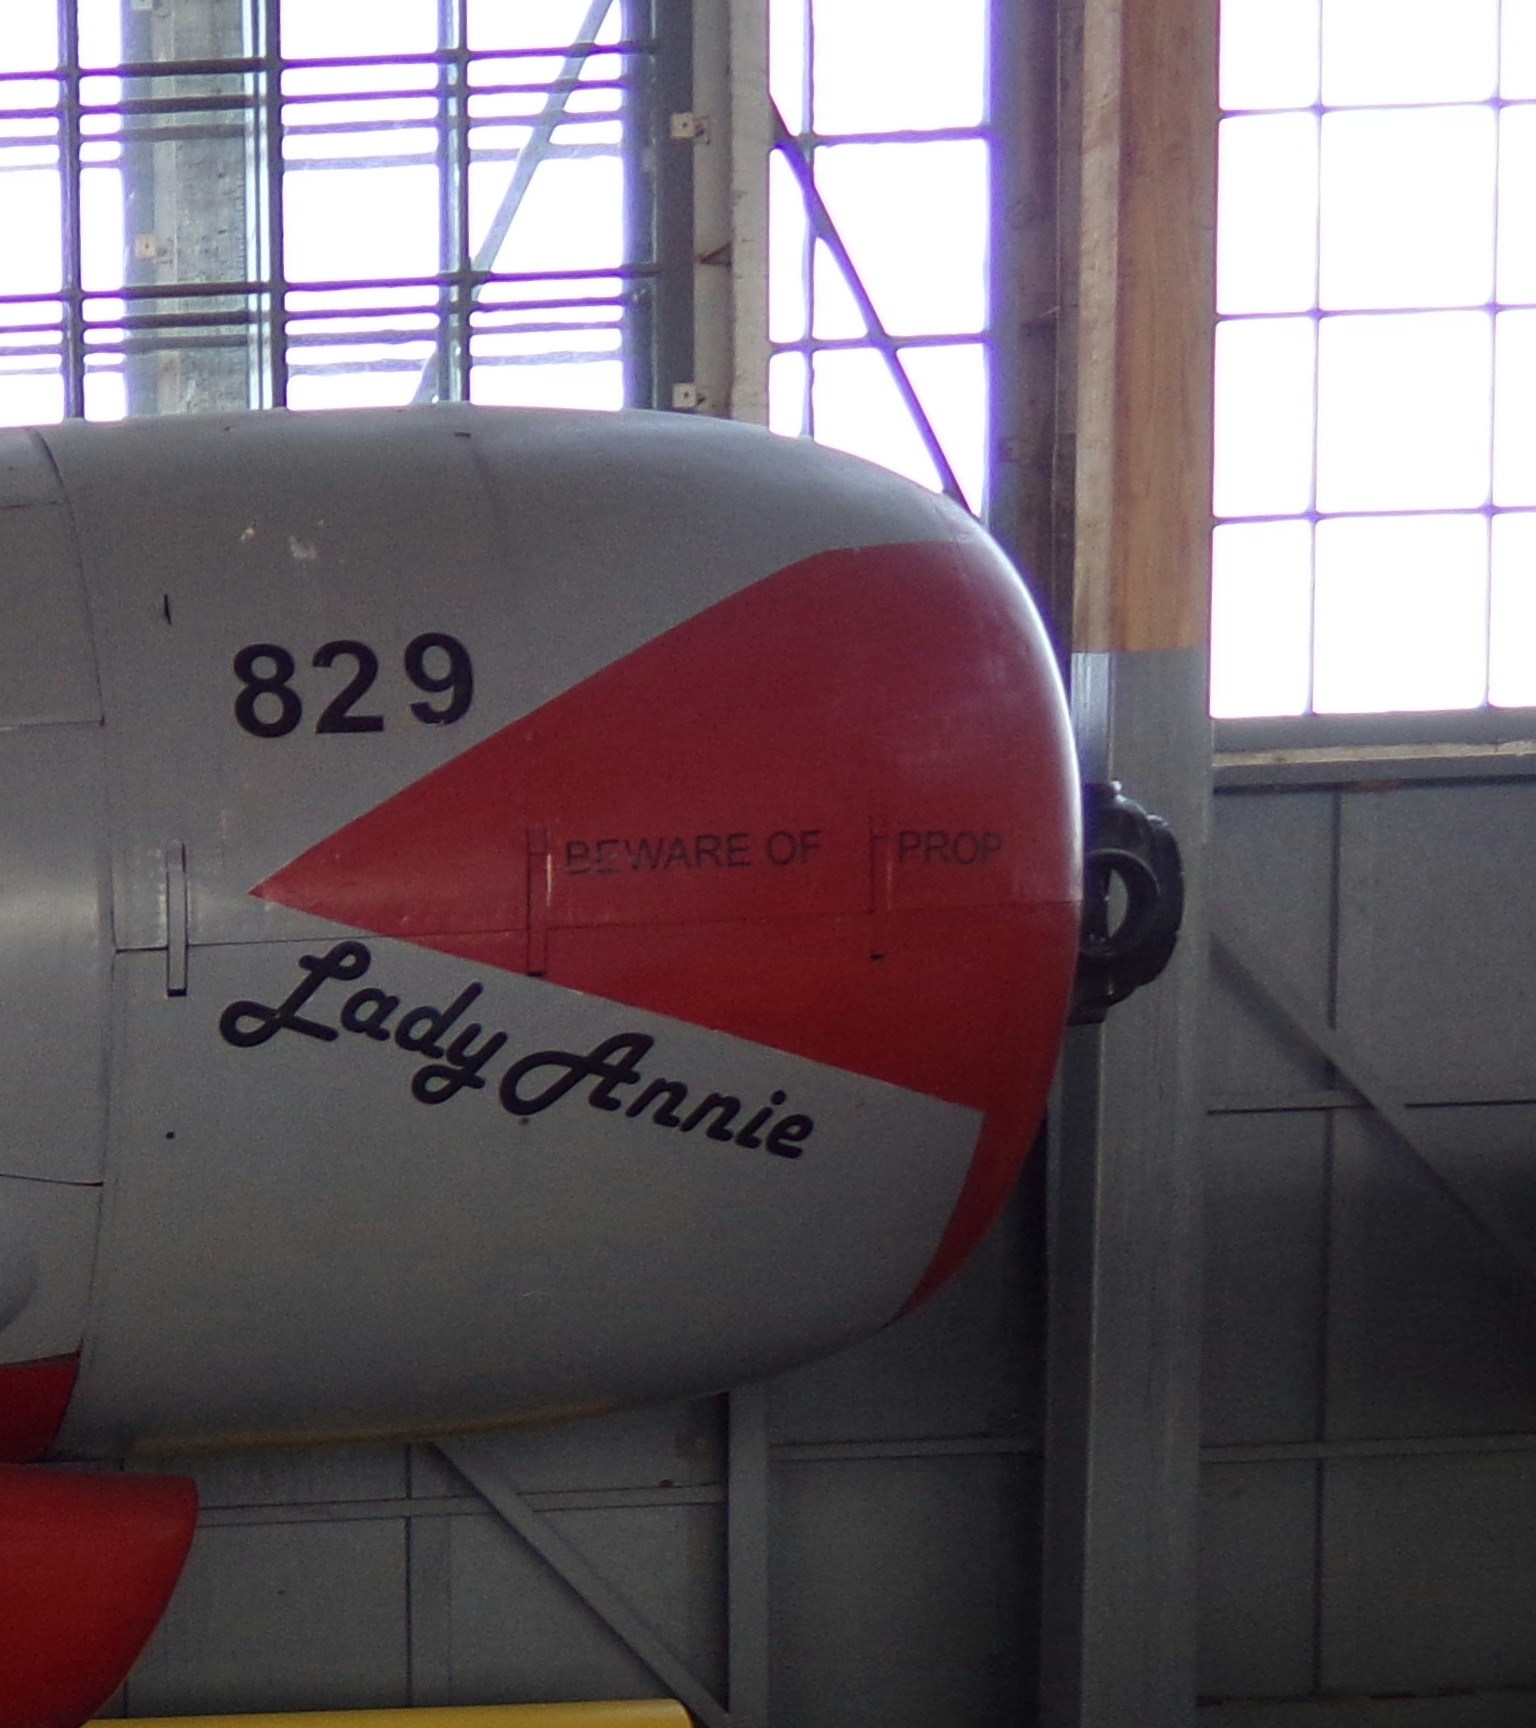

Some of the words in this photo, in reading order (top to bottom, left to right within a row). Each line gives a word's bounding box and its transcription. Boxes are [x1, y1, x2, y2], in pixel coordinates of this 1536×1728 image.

[232, 632, 476, 740] 829
[564, 832, 751, 875] BEWARE
[766, 829, 823, 867] OF
[899, 828, 1003, 865] PROP
[218, 941, 509, 1106] Lady
[499, 1030, 816, 1161] Annie
